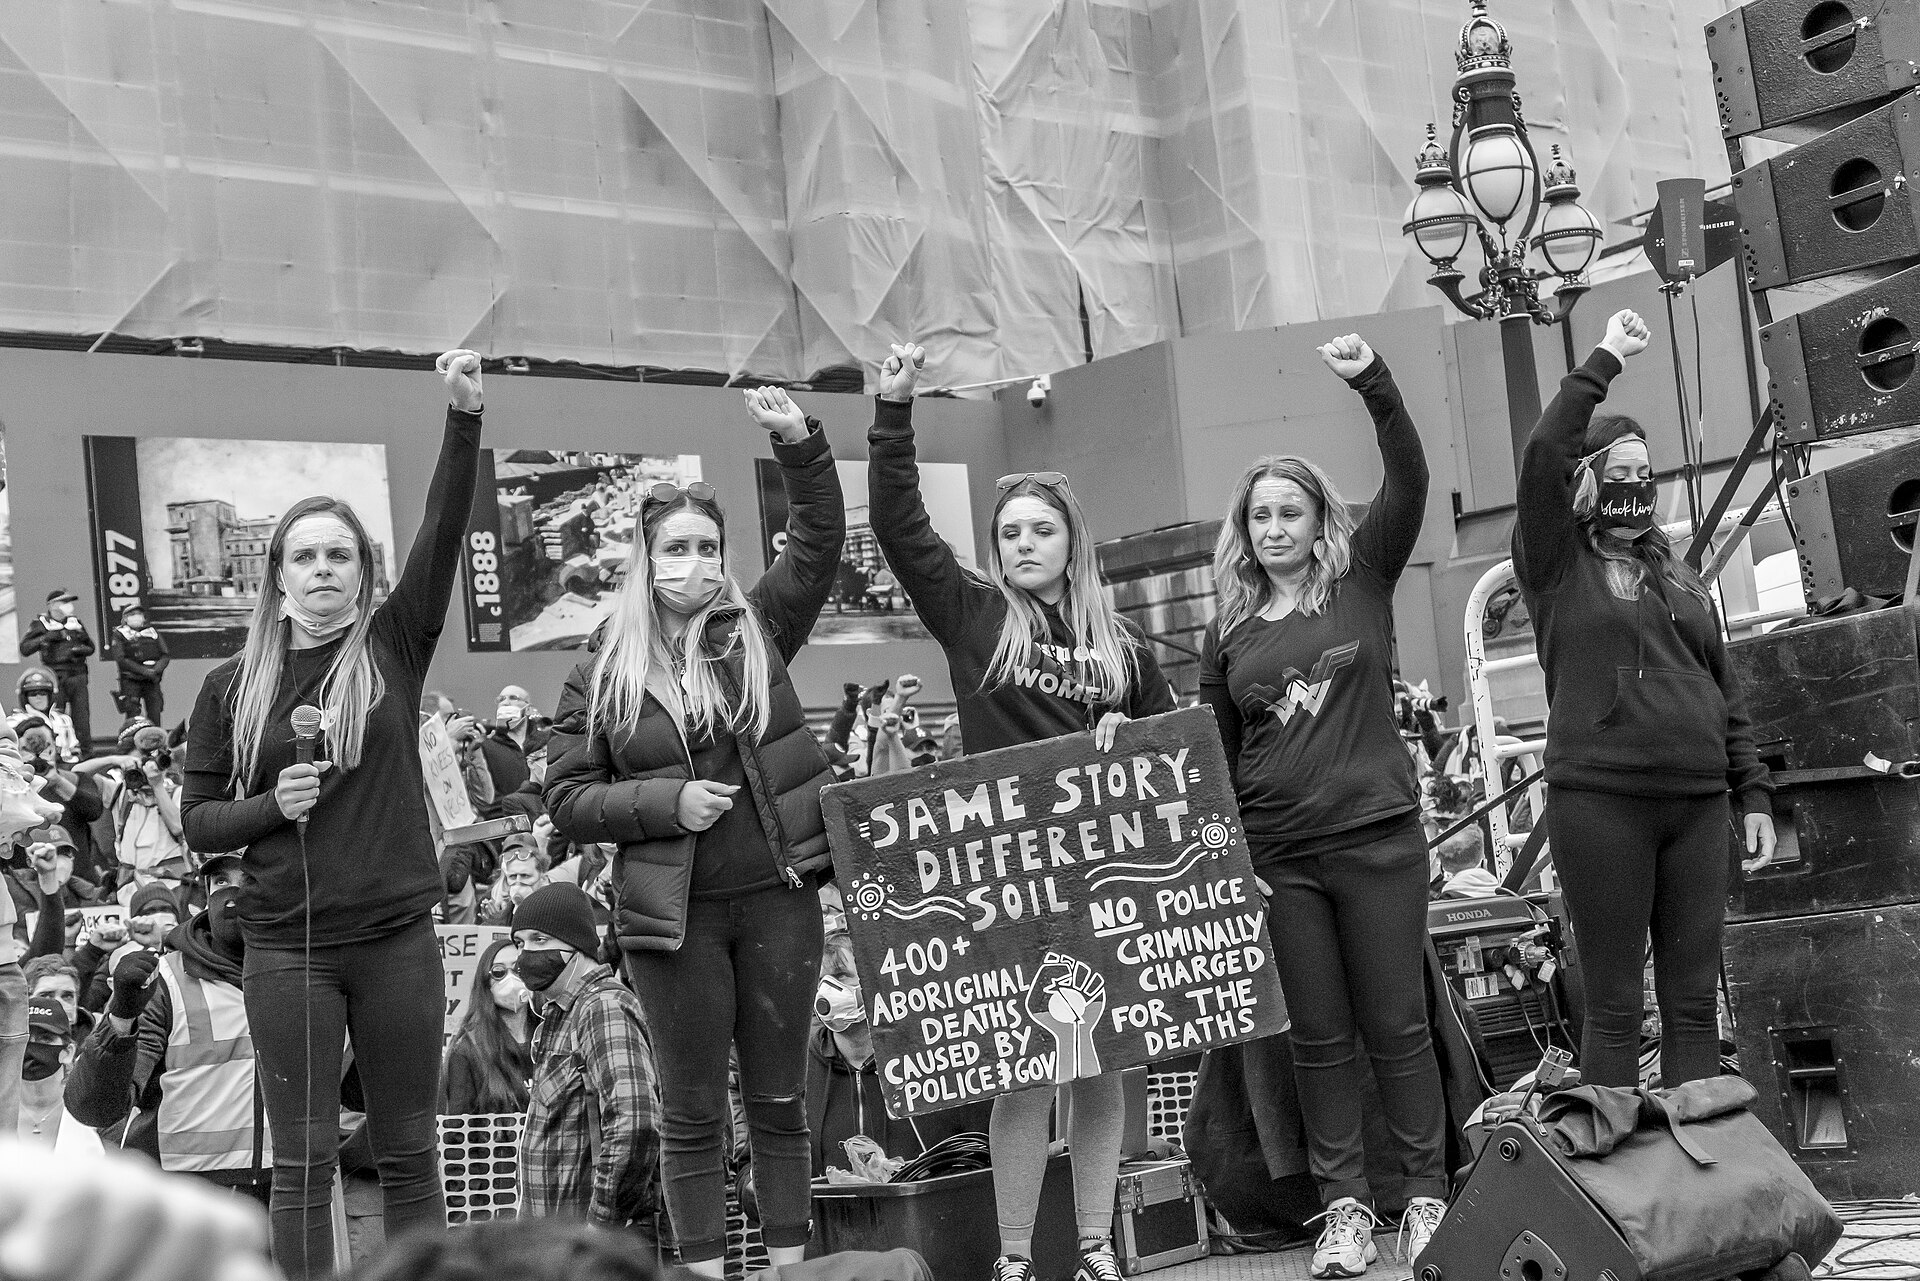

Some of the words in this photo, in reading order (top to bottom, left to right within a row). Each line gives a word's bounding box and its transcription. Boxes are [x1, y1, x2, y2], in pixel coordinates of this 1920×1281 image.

[1601, 499, 1631, 517] black
[104, 529, 141, 612] 1877
[1013, 665, 1107, 704] WOME
[423, 731, 437, 753] NO
[871, 775, 1027, 849] SAME
[1051, 747, 1190, 815] STORY
[915, 800, 1189, 894] DIFFERENT
[965, 876, 1070, 932] SOIL
[1089, 897, 1138, 930] NO
[1156, 877, 1246, 923] POLICE
[1446, 909, 1493, 922] HONDA
[879, 935, 971, 986] 400+
[1117, 910, 1264, 966] CRIMINALLY
[872, 963, 1031, 1026] ABORIGINAL
[1138, 945, 1266, 992] CHARGED
[921, 1000, 1022, 1045] DEATHS
[1112, 999, 1173, 1033] FOR
[1186, 978, 1257, 1017] THE
[1144, 1008, 1256, 1056] DEATHS
[884, 1040, 980, 1085] CAUSED
[994, 1025, 1032, 1058] BY
[903, 1063, 995, 1111] POLICE
[1014, 1051, 1056, 1084] GOV
